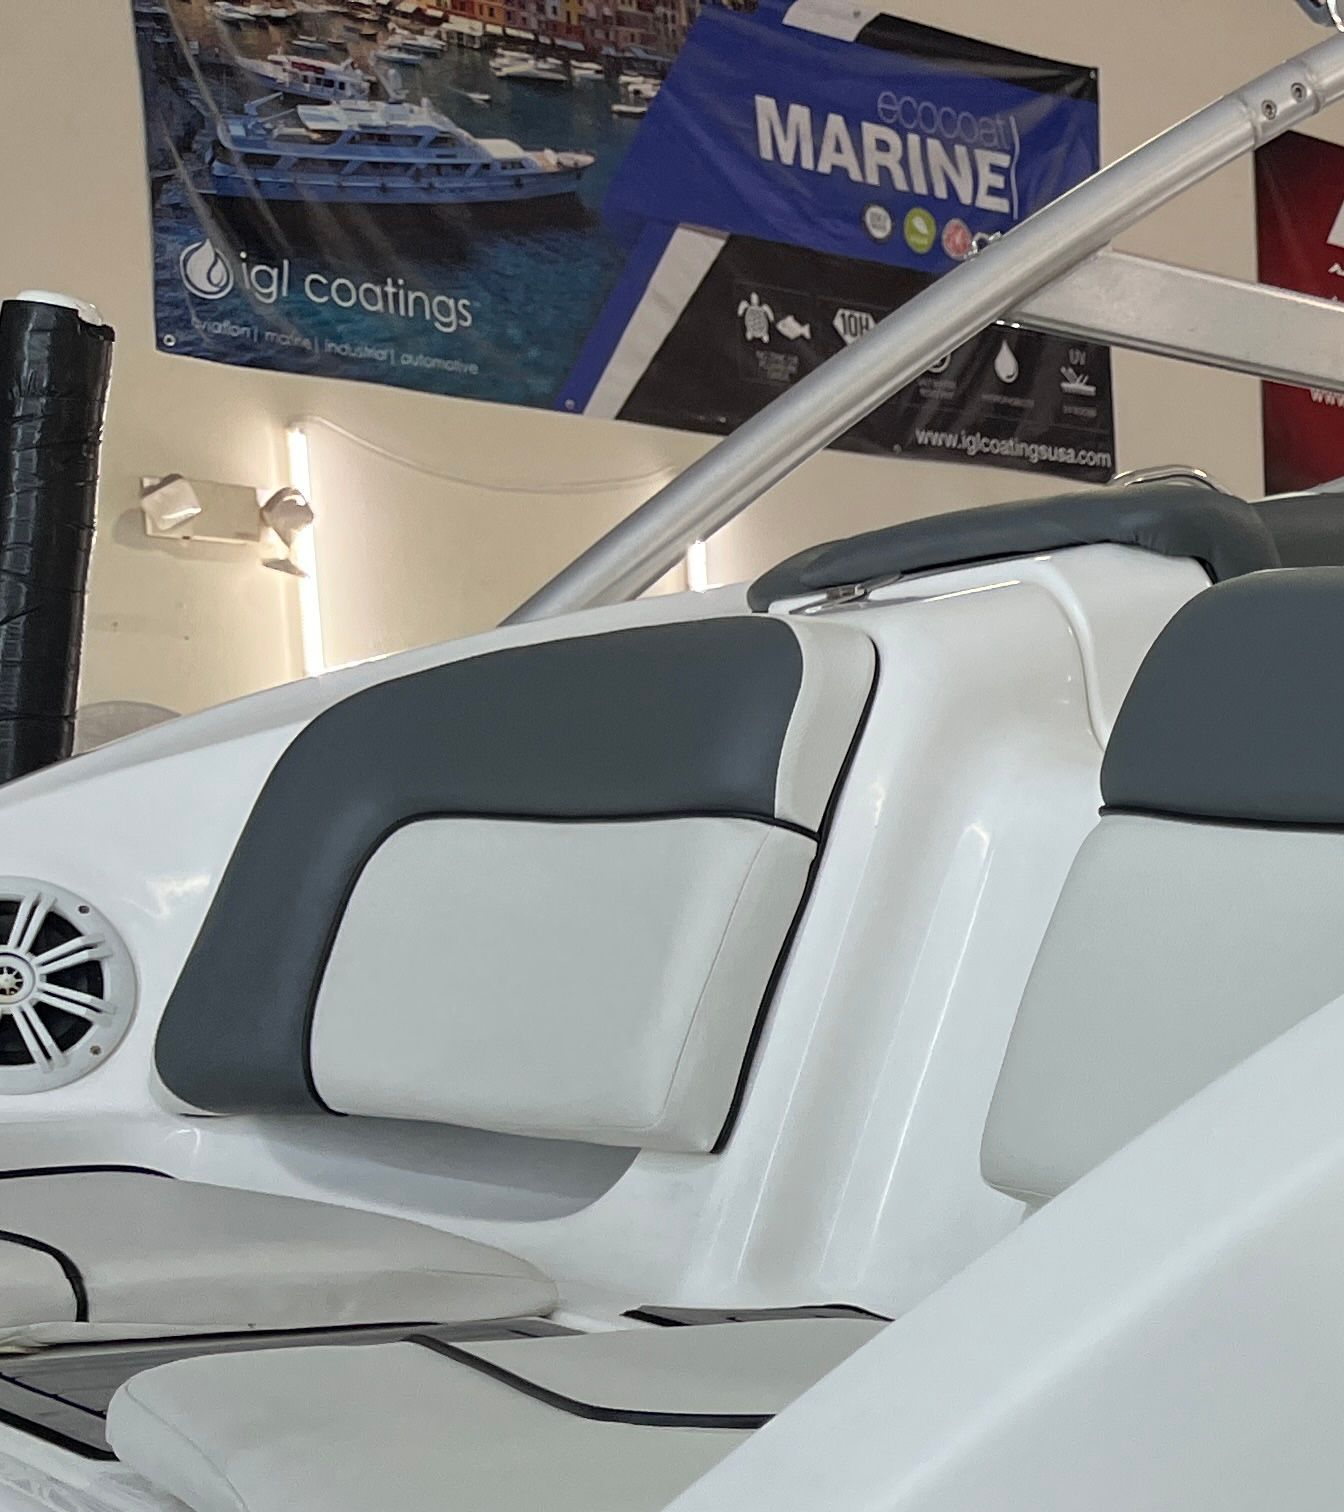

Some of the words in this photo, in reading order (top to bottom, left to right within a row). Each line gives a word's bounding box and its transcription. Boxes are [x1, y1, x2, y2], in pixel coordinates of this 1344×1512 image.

[754, 94, 1011, 214] MARINE
[239, 251, 290, 304] igl
[304, 273, 473, 333] coatings
[400, 353, 479, 376] automotive
[915, 426, 1112, 468] www.iglcoatingsusa.com
